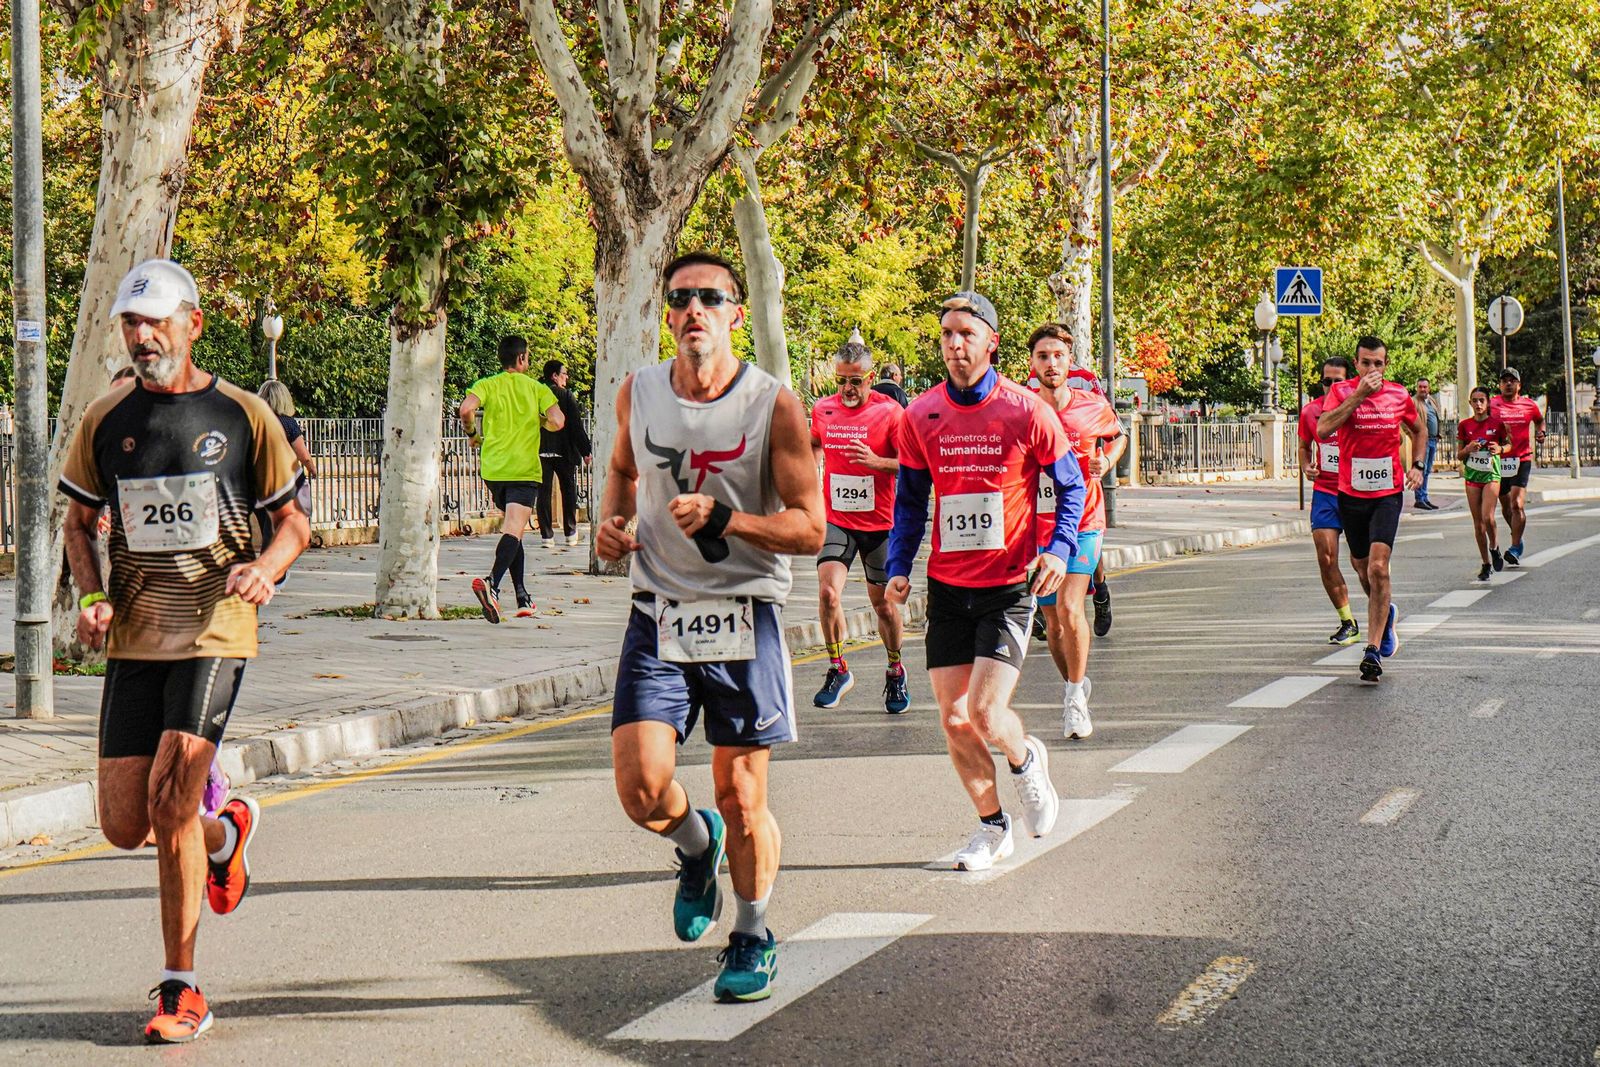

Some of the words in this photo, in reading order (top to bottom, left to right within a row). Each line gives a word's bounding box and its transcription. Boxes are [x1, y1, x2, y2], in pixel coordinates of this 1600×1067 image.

[1356, 412, 1395, 420] humanidad
[826, 431, 868, 439] humanidad
[939, 434, 987, 444] kilómetros
[989, 433, 1002, 443] de
[940, 445, 1003, 456] humanidad
[1470, 456, 1490, 465] 1763
[938, 464, 1008, 474] #CarreraCruzRoja
[1358, 469, 1388, 480] 1066
[835, 487, 868, 500] 1294
[1038, 486, 1057, 499] 18
[142, 502, 194, 525] 266
[946, 513, 993, 531] 1319
[671, 613, 736, 637] 1491
